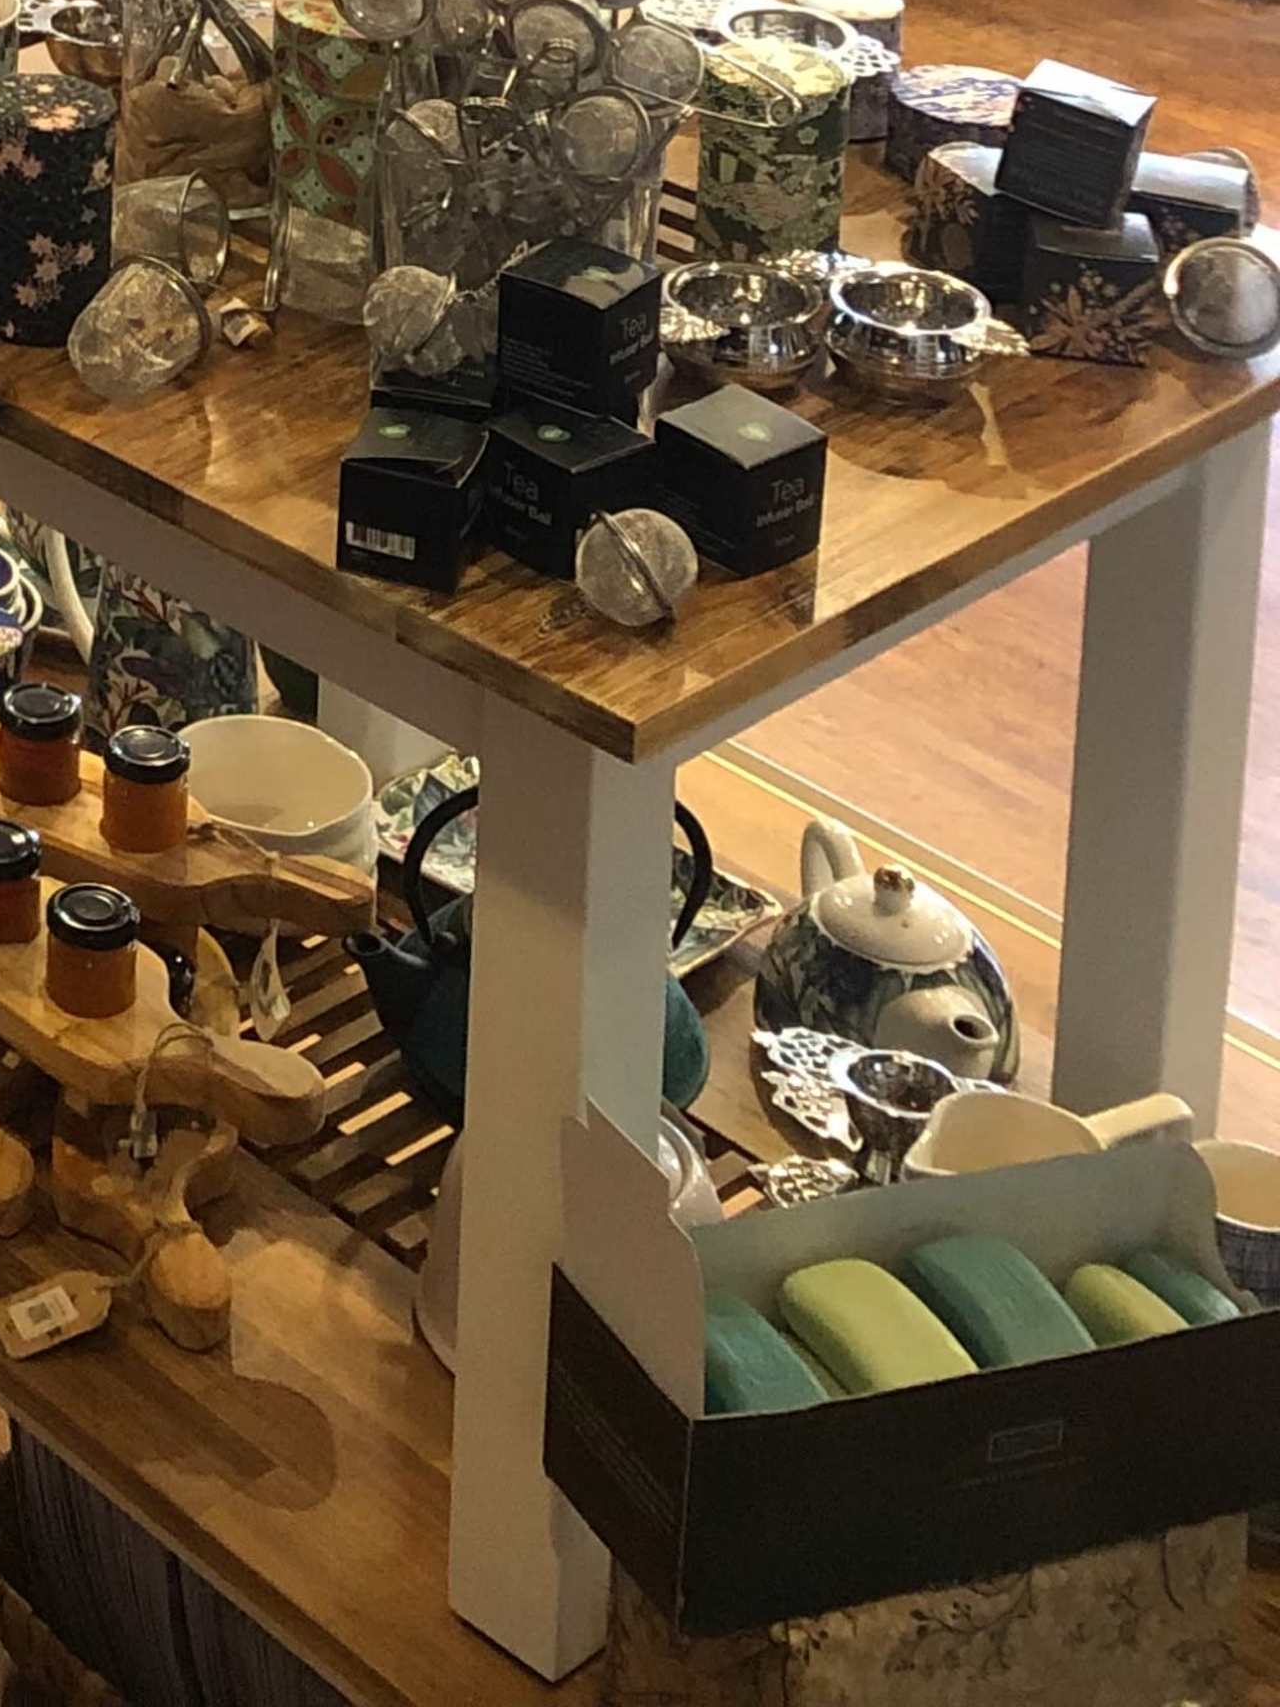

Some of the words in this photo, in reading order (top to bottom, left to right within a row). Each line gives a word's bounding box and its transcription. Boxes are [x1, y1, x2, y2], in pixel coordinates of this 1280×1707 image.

[618, 313, 647, 340] Tea
[503, 460, 540, 501] Tea
[769, 476, 806, 505] Tea
